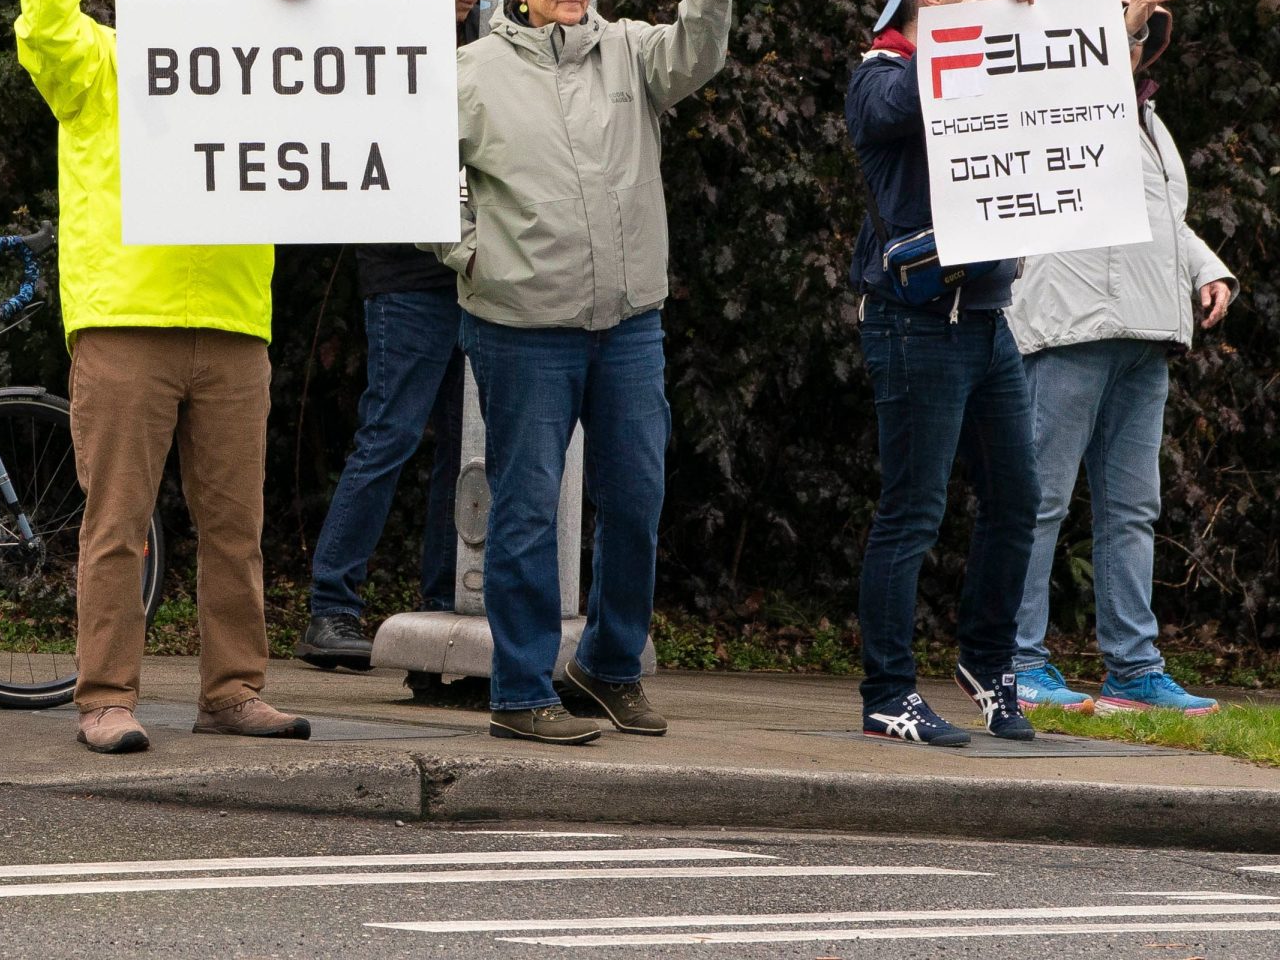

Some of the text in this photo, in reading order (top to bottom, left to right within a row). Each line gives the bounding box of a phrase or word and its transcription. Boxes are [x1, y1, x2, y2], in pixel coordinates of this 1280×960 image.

[147, 45, 428, 96] BOYCOTT
[931, 24, 1109, 99] FELON
[931, 103, 1126, 136] CHOOSE INTEGRITY!
[194, 141, 391, 192] TESLA
[950, 143, 1105, 182] DON'T BUY
[975, 188, 1084, 221] TESLA!
